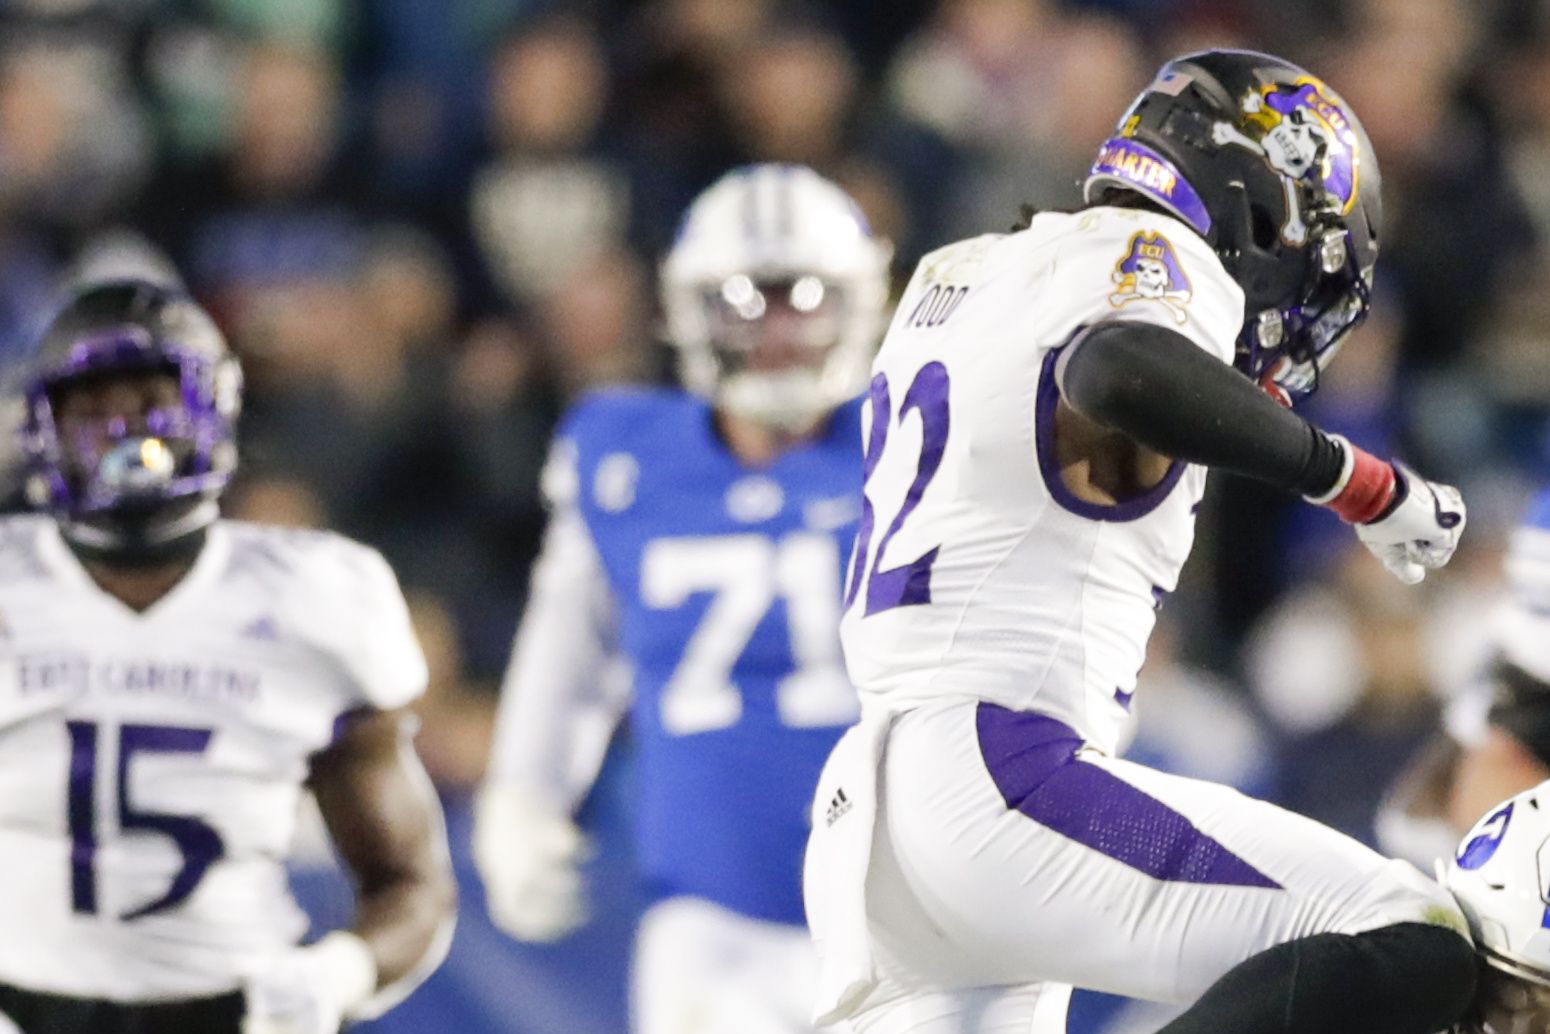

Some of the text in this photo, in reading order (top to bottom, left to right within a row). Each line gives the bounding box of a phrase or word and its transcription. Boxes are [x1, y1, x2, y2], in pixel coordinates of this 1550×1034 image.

[1099, 147, 1176, 199] UARTER
[1138, 243, 1164, 259] ECU
[642, 532, 863, 736] 71
[65, 719, 227, 922] 15
